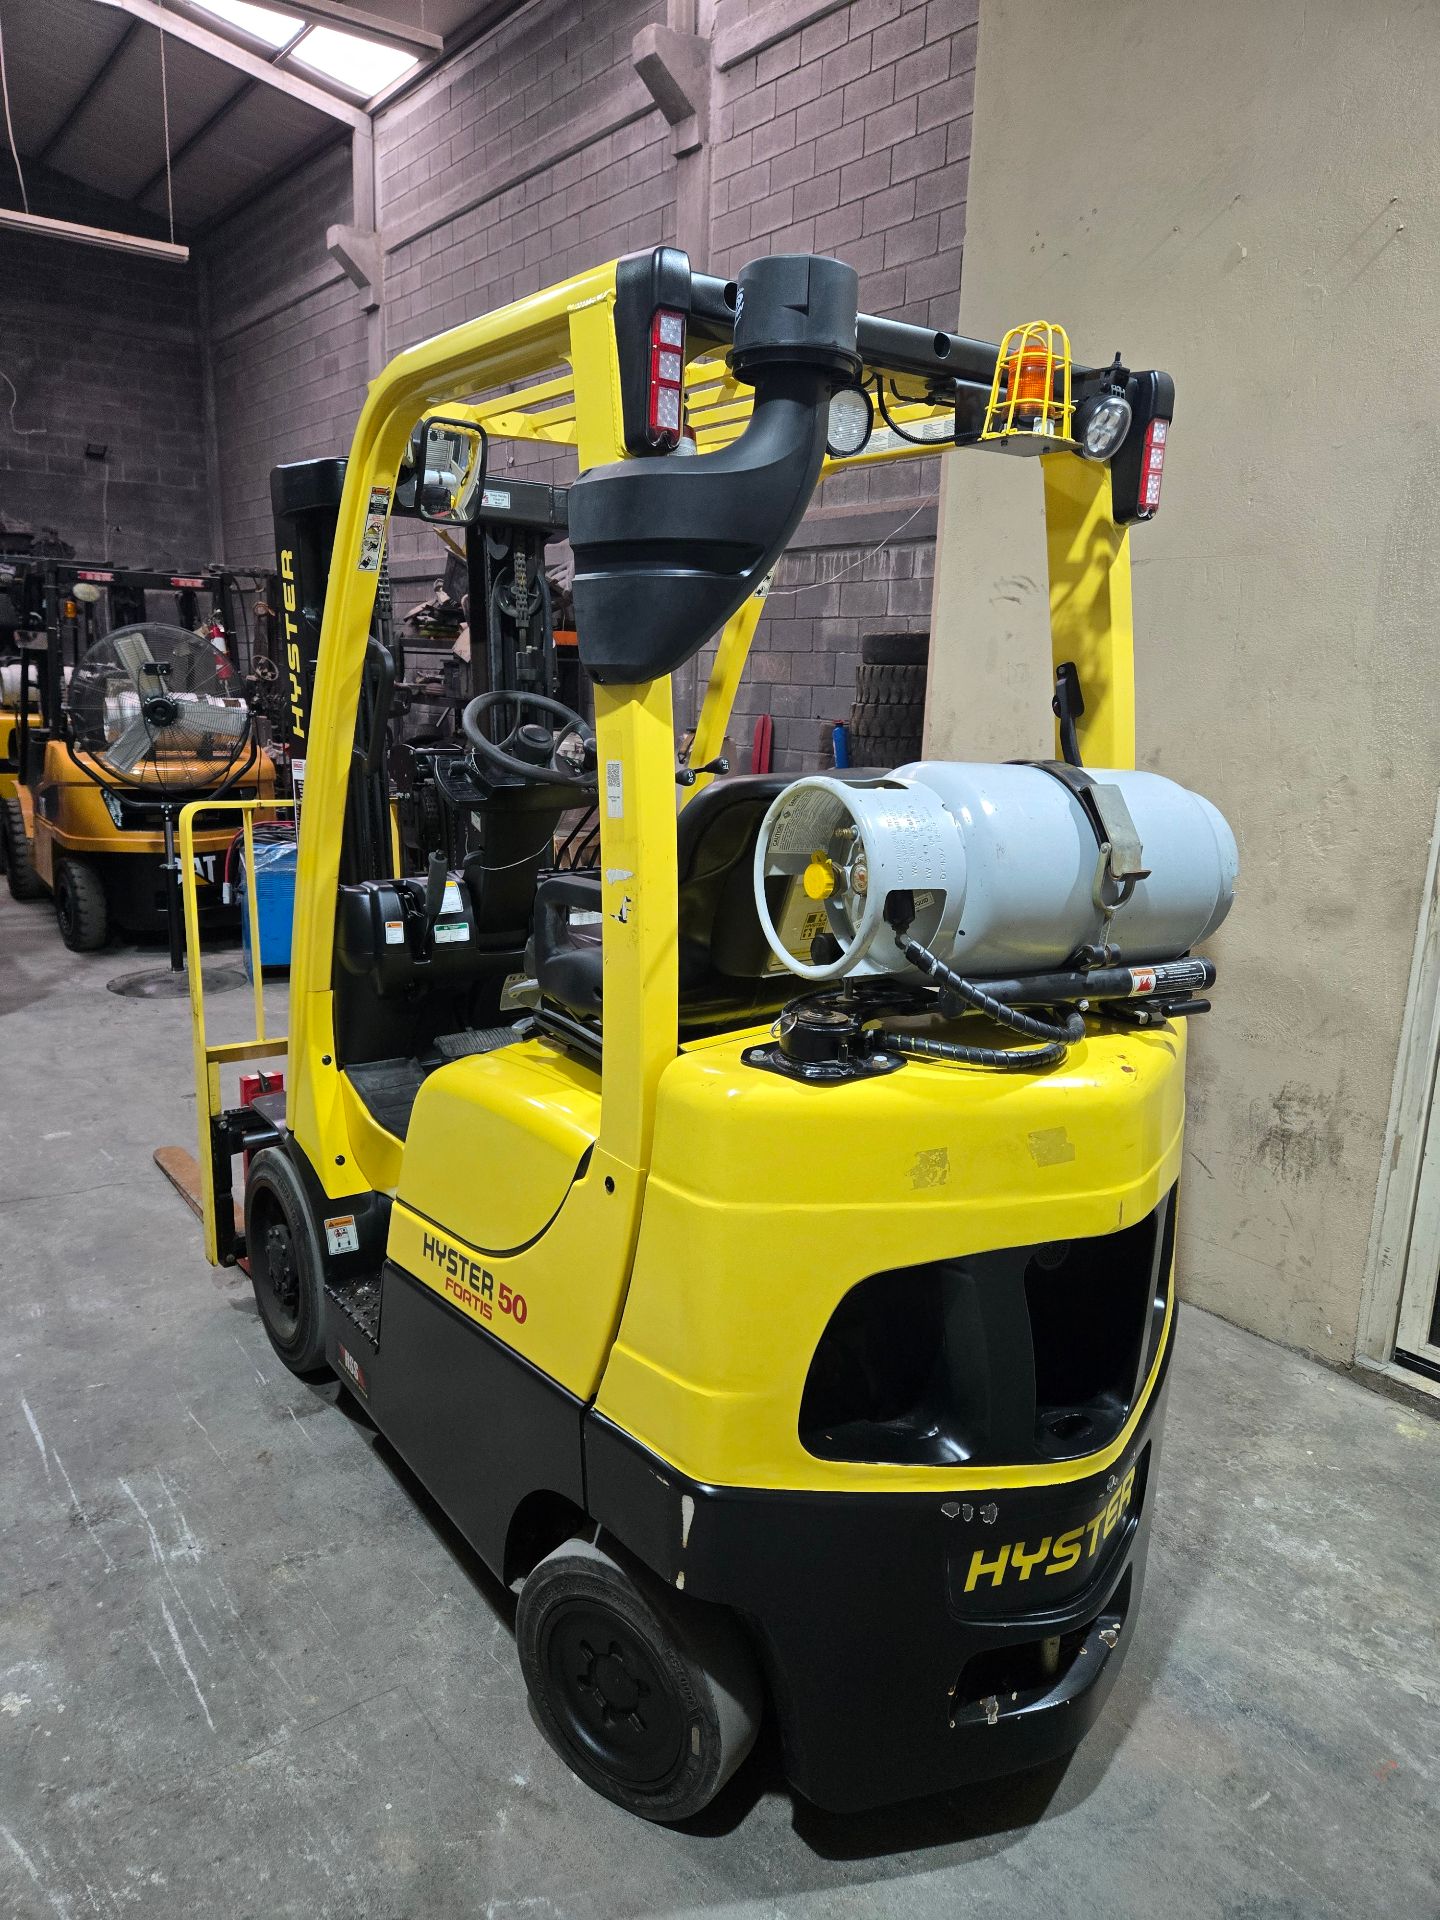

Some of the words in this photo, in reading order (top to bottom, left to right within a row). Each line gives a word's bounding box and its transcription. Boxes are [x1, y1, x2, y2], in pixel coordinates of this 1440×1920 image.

[281, 549, 305, 739] HYSTER
[423, 1232, 494, 1301] HYSTER
[498, 1282, 528, 1324] 50
[445, 1277, 493, 1321] FORTIS
[963, 1466, 1136, 1592] HYSTER
